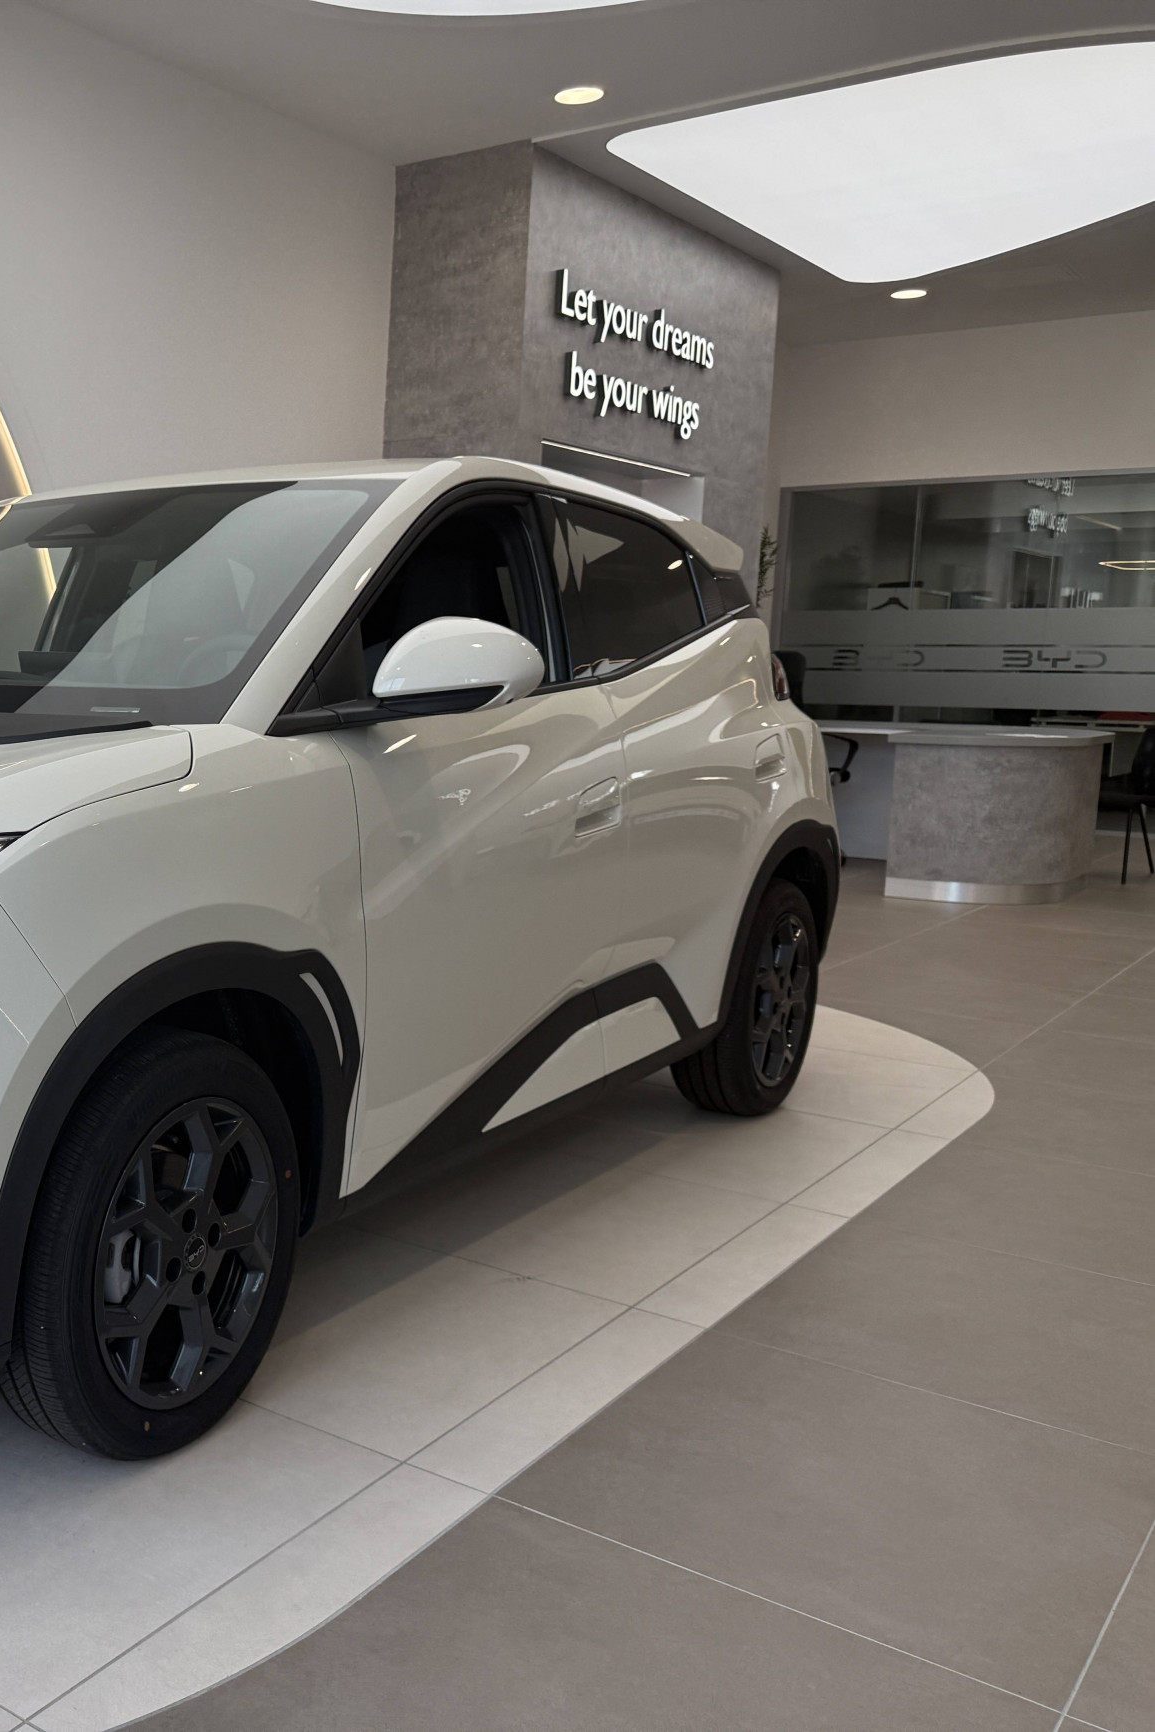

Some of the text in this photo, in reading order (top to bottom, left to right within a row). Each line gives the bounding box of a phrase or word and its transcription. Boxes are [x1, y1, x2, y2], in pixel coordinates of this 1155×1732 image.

[560, 267, 715, 370] Let your dreams
[569, 350, 700, 440] be your wings
[1002, 648, 1108, 669] BYD
